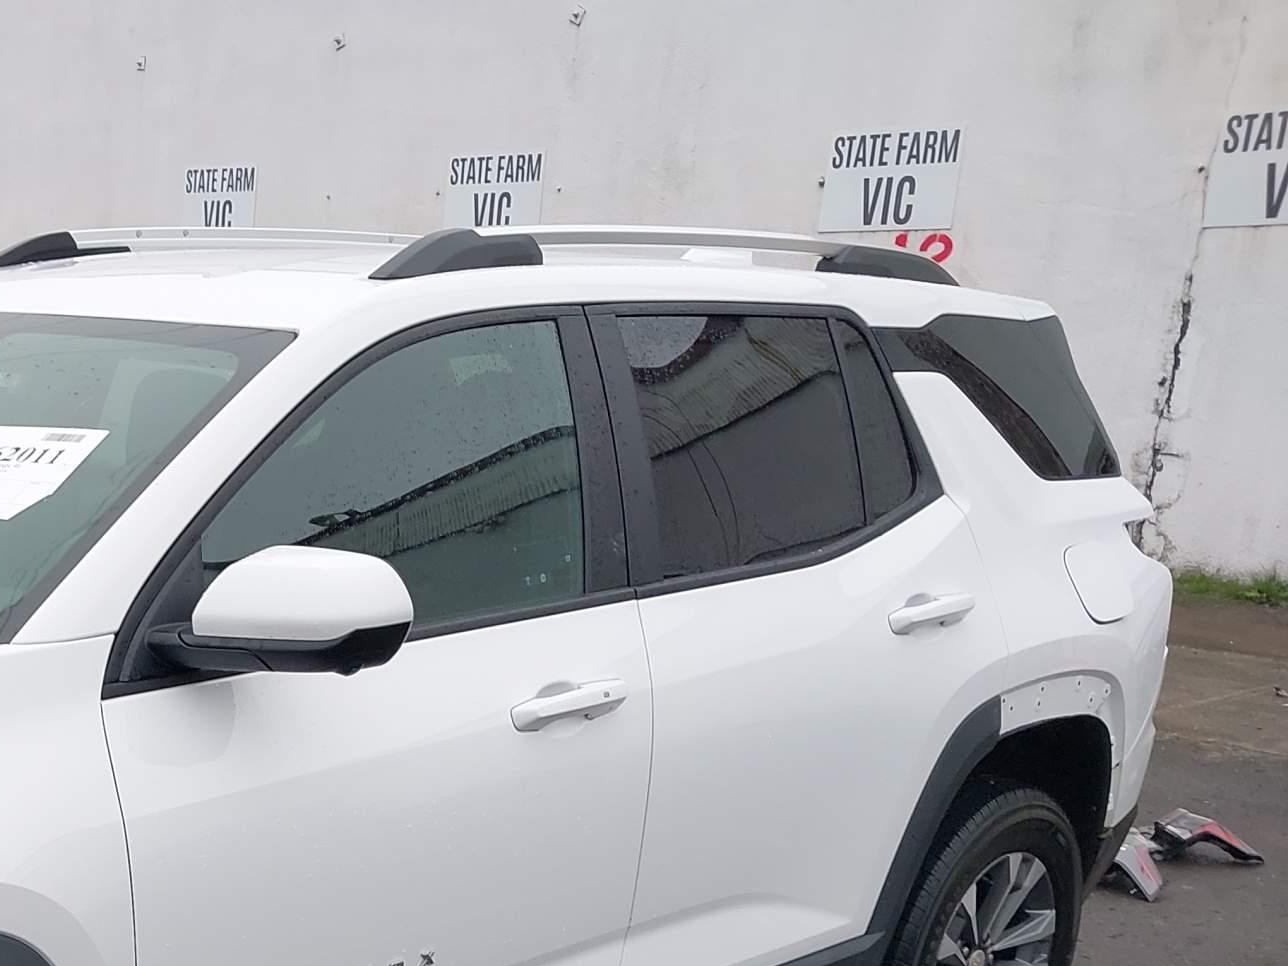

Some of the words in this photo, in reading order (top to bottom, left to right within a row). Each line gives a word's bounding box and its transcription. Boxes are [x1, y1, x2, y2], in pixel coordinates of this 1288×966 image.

[832, 133, 890, 169] STATE
[895, 129, 961, 166] FARM
[185, 168, 218, 194] STATE
[220, 167, 256, 193] FARM
[450, 156, 494, 186] STATE
[496, 153, 543, 184] FARM
[203, 199, 234, 228] VIC
[473, 191, 512, 227] VIC
[862, 175, 916, 226] VIC
